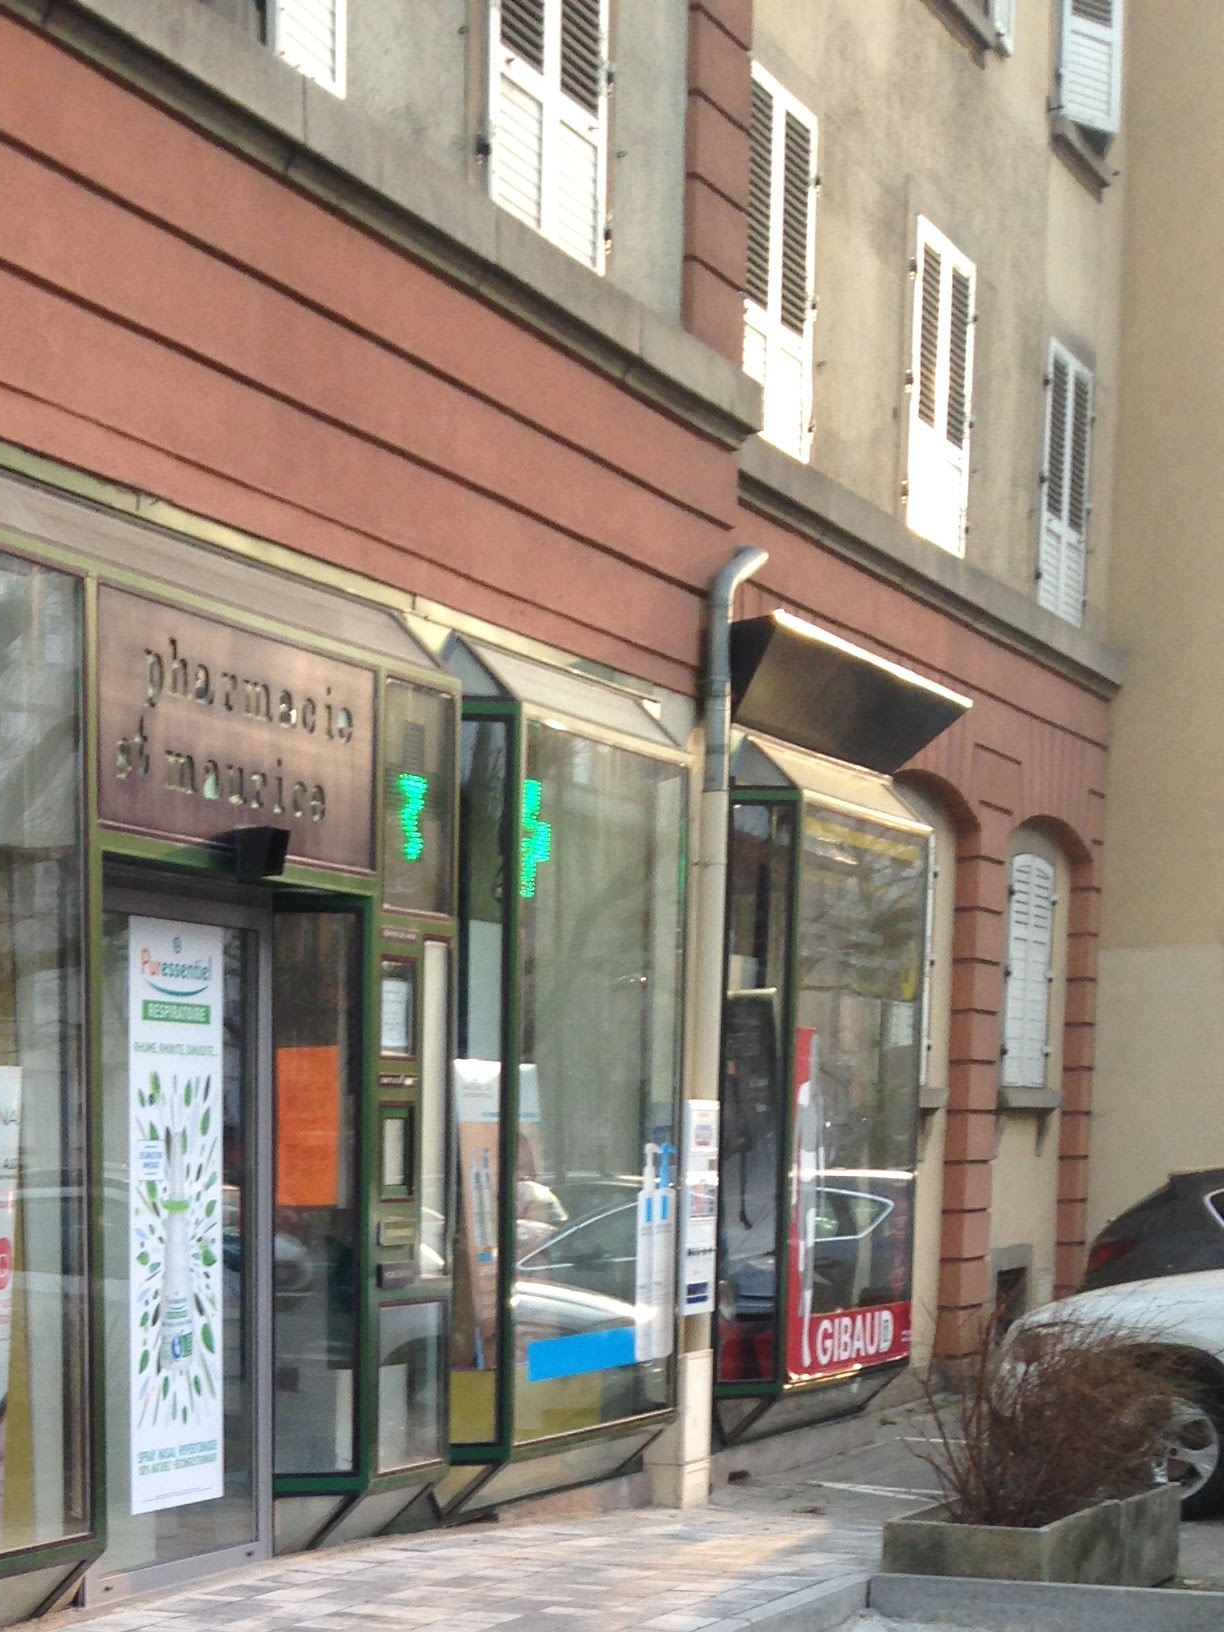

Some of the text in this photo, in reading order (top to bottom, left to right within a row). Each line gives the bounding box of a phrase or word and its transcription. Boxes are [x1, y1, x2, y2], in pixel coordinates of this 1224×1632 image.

[145, 637, 353, 743] pharmacie
[164, 749, 325, 823] maurice
[140, 947, 212, 981] Puressentiel
[817, 1310, 893, 1365] GIBAUD
